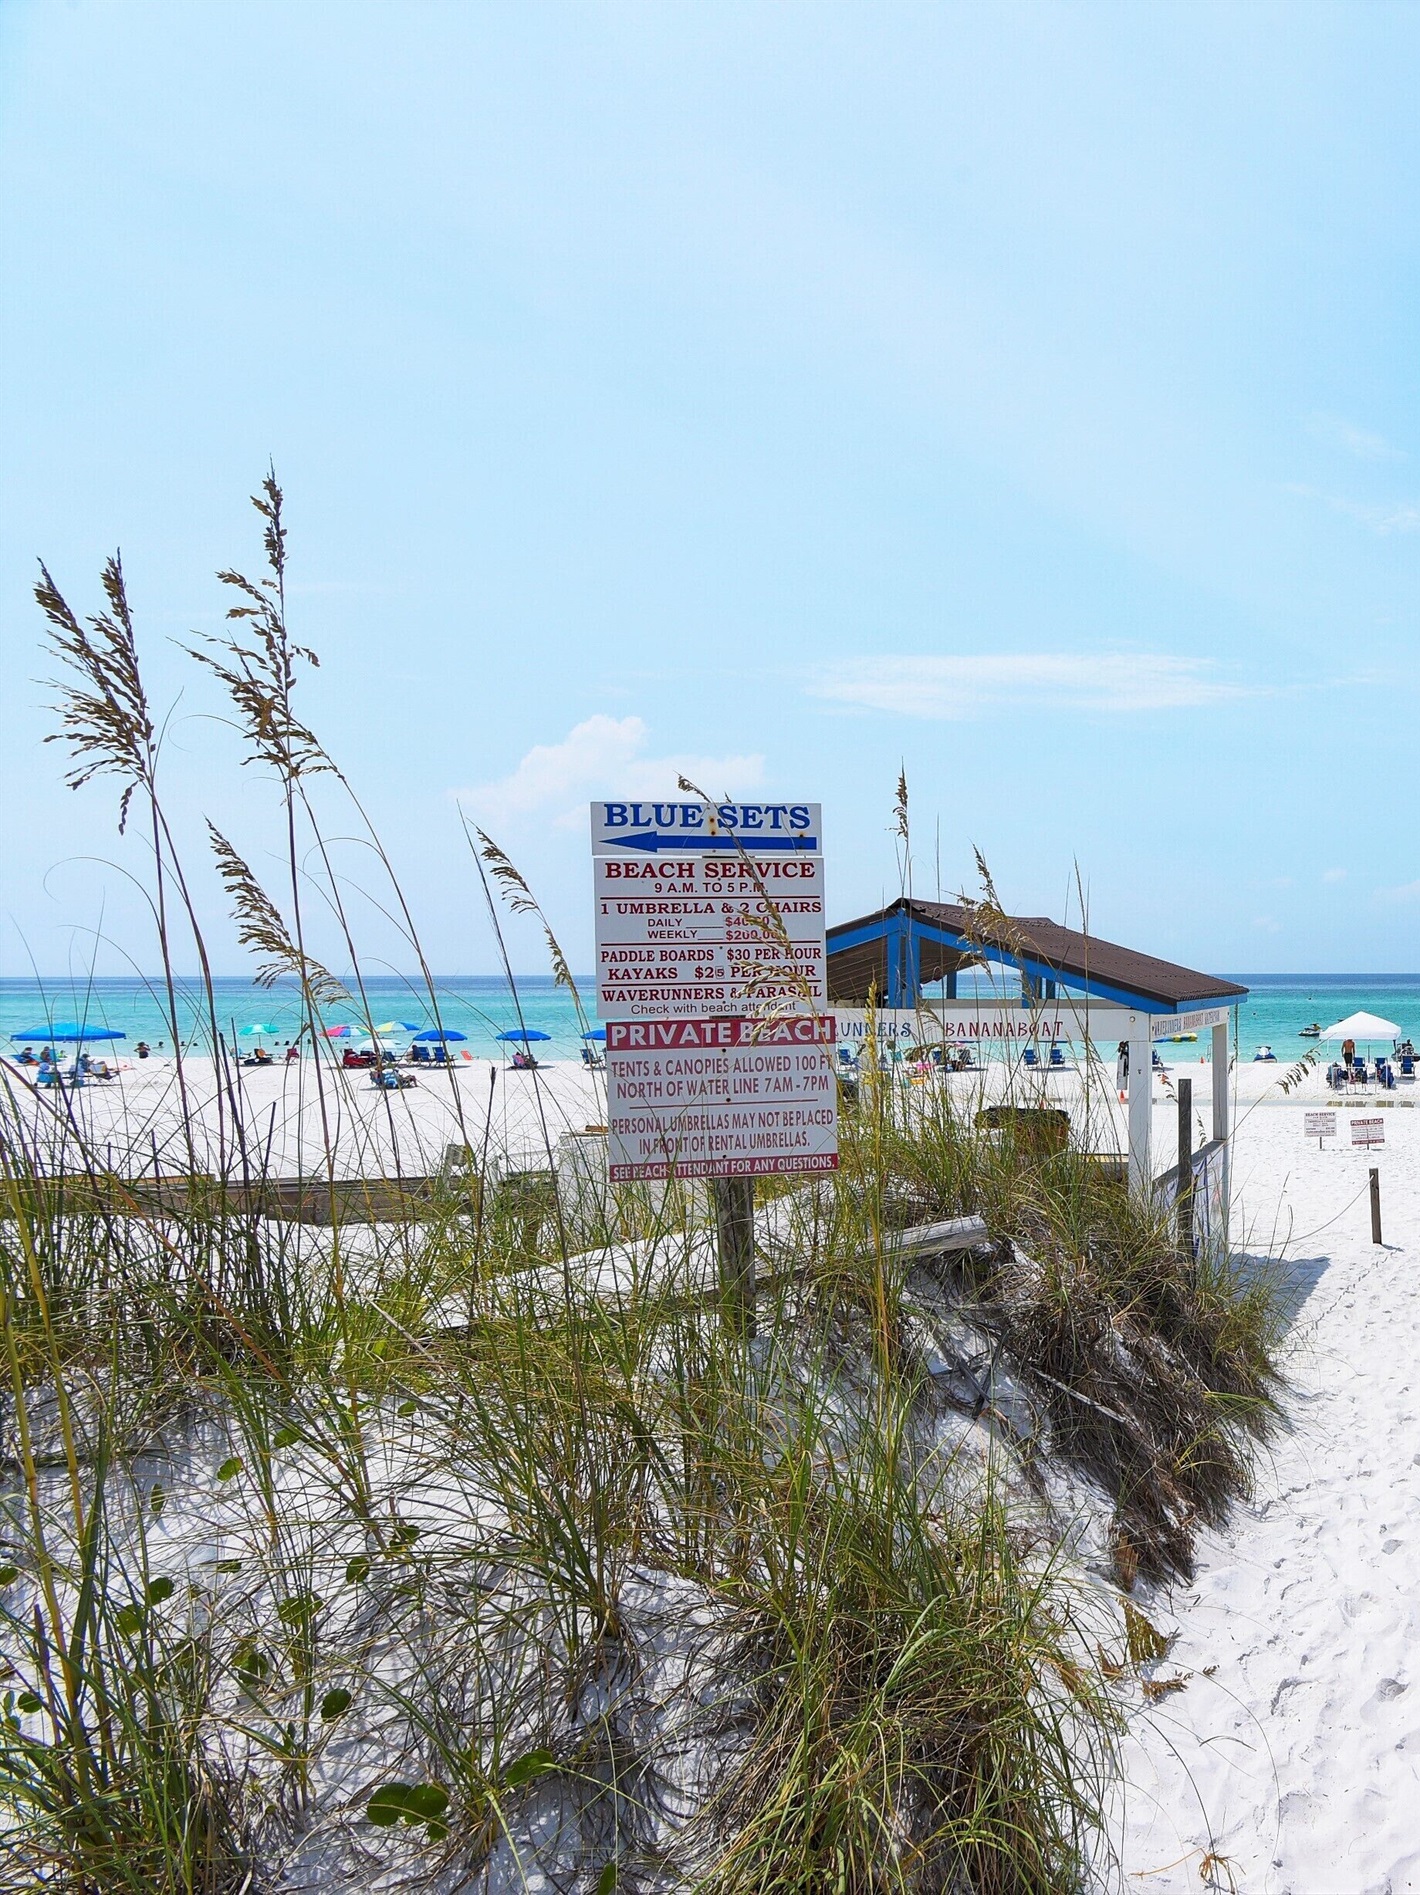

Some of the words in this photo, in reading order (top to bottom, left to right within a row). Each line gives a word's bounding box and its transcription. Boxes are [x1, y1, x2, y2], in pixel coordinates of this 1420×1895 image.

[604, 803, 704, 828] BLUE
[717, 805, 811, 829] SETS
[605, 862, 695, 879] BEACH
[704, 862, 816, 879] SERVICE
[654, 882, 663, 893] 9
[667, 882, 698, 893] A.M.
[702, 882, 723, 893] TO
[727, 882, 735, 893] 5
[739, 882, 769, 893] P.M.
[601, 903, 609, 915] 1
[616, 902, 716, 915] UMBRELLA
[721, 902, 734, 914] &
[740, 902, 750, 914] 2
[647, 918, 683, 928] DAILY
[647, 930, 698, 939] WEEKLY
[601, 951, 656, 963] PADDLE
[659, 949, 715, 962] BOARDS
[726, 948, 751, 962] $30
[754, 948, 781, 961] PER
[784, 947, 822, 960] HOUR
[607, 967, 679, 981] KAYAKS
[694, 965, 725, 981] $25
[601, 987, 725, 1003] WAVERUNNERS
[630, 1004, 670, 1015] Check
[673, 1003, 697, 1013] with
[701, 1001, 738, 1013] beach
[741, 1001, 796, 1012] attendnt
[611, 1022, 732, 1047] PRIVATE
[740, 1019, 831, 1043] BEACH
[944, 1021, 1064, 1038] BANANABOAT
[611, 1061, 650, 1077] TENTS
[653, 1061, 662, 1076] &
[665, 1057, 729, 1076] CANOPIES
[733, 1055, 791, 1073] ALLOWED
[795, 1055, 817, 1071] 100
[617, 1081, 662, 1099] NORTH
[666, 1080, 683, 1097] OF
[686, 1078, 730, 1096] WATER
[733, 1078, 759, 1094] LINE
[765, 1076, 794, 1093] 7AM
[803, 1075, 829, 1091] 7PM
[612, 1117, 668, 1135] PERSONAL
[670, 1113, 729, 1132] UMBRELLAS
[732, 1112, 756, 1129] MAY
[758, 1111, 780, 1127] NOT
[782, 1110, 794, 1127] BE
[796, 1109, 834, 1126] PLACED
[639, 1139, 651, 1155] IN
[654, 1137, 689, 1154] FRONT
[691, 1136, 706, 1152] OF
[708, 1133, 747, 1151] RENTAL
[749, 1131, 810, 1149] UMBRELLAS.
[613, 1166, 630, 1180] SEE
[672, 1161, 729, 1176] TTENDANT
[731, 1160, 752, 1173] FOR
[754, 1158, 776, 1172] ANY
[777, 1156, 835, 1170] QUESTIONS.
